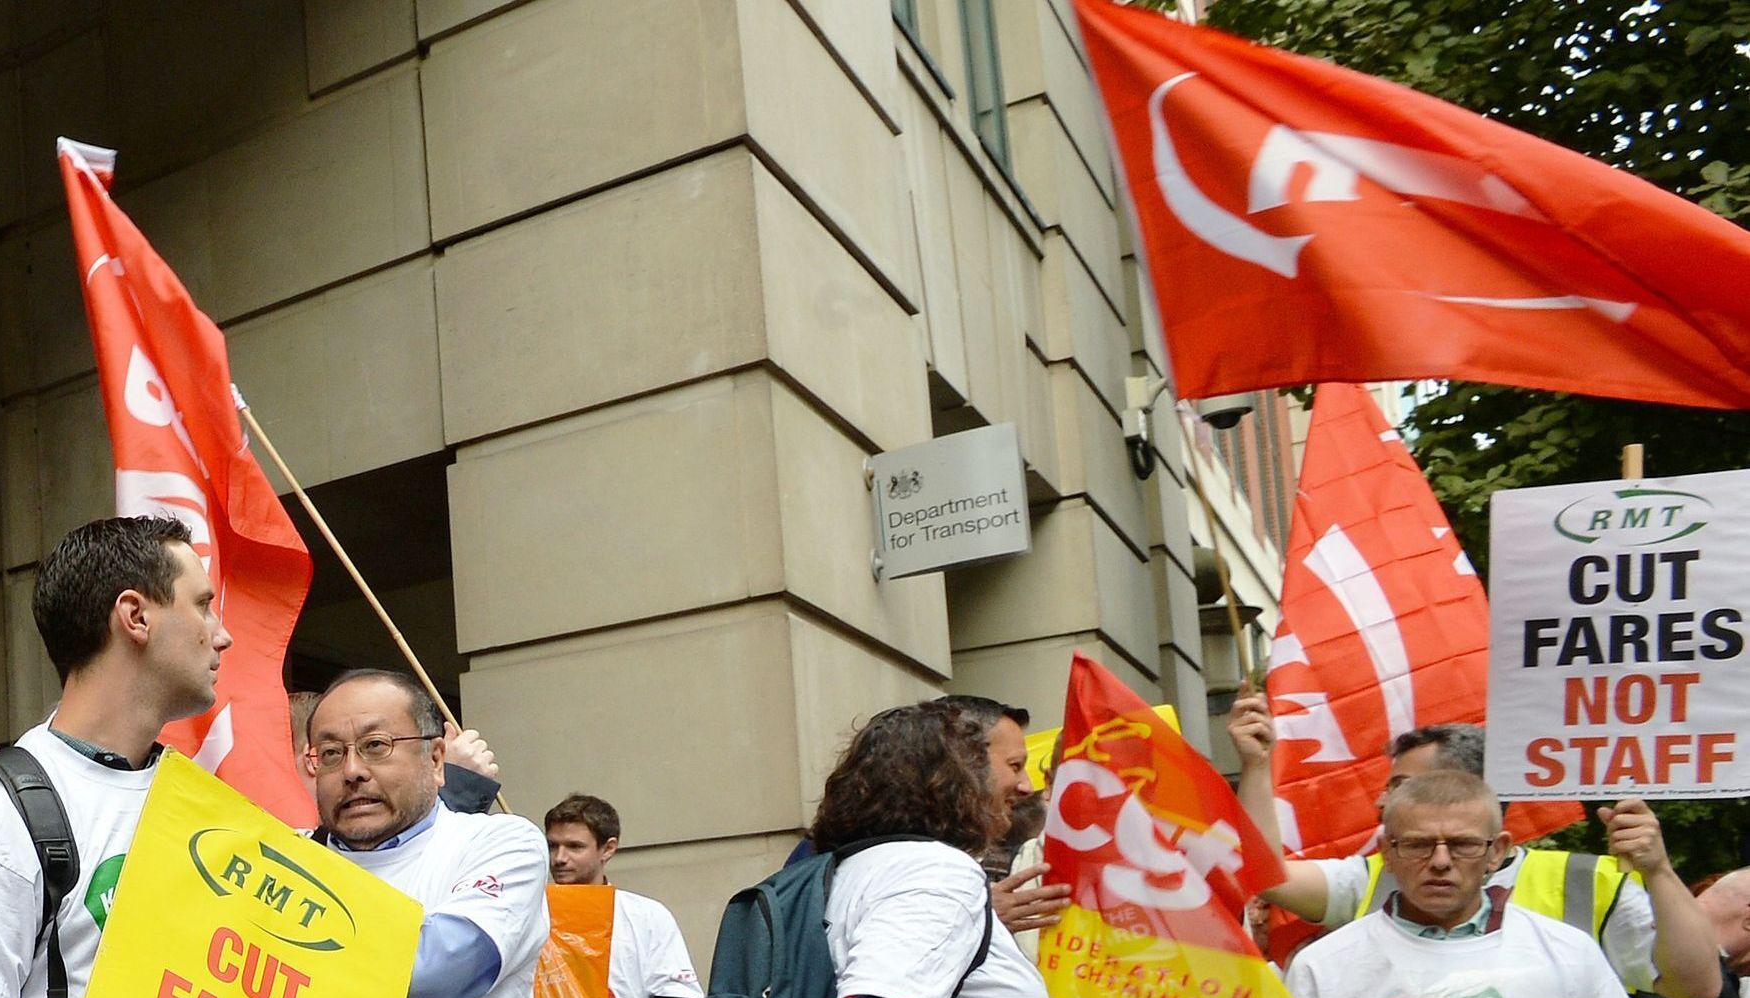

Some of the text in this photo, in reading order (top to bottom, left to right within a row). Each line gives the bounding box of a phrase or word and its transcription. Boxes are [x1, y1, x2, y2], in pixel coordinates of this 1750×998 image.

[888, 488, 1009, 529] Department
[890, 509, 1021, 550] for Transport
[1588, 505, 1684, 531] RMT
[1568, 550, 1701, 605] CUT
[1523, 608, 1744, 668] FARES
[1563, 672, 1701, 726] NOT
[1524, 733, 1736, 788] STAFF
[220, 853, 327, 928] RMT
